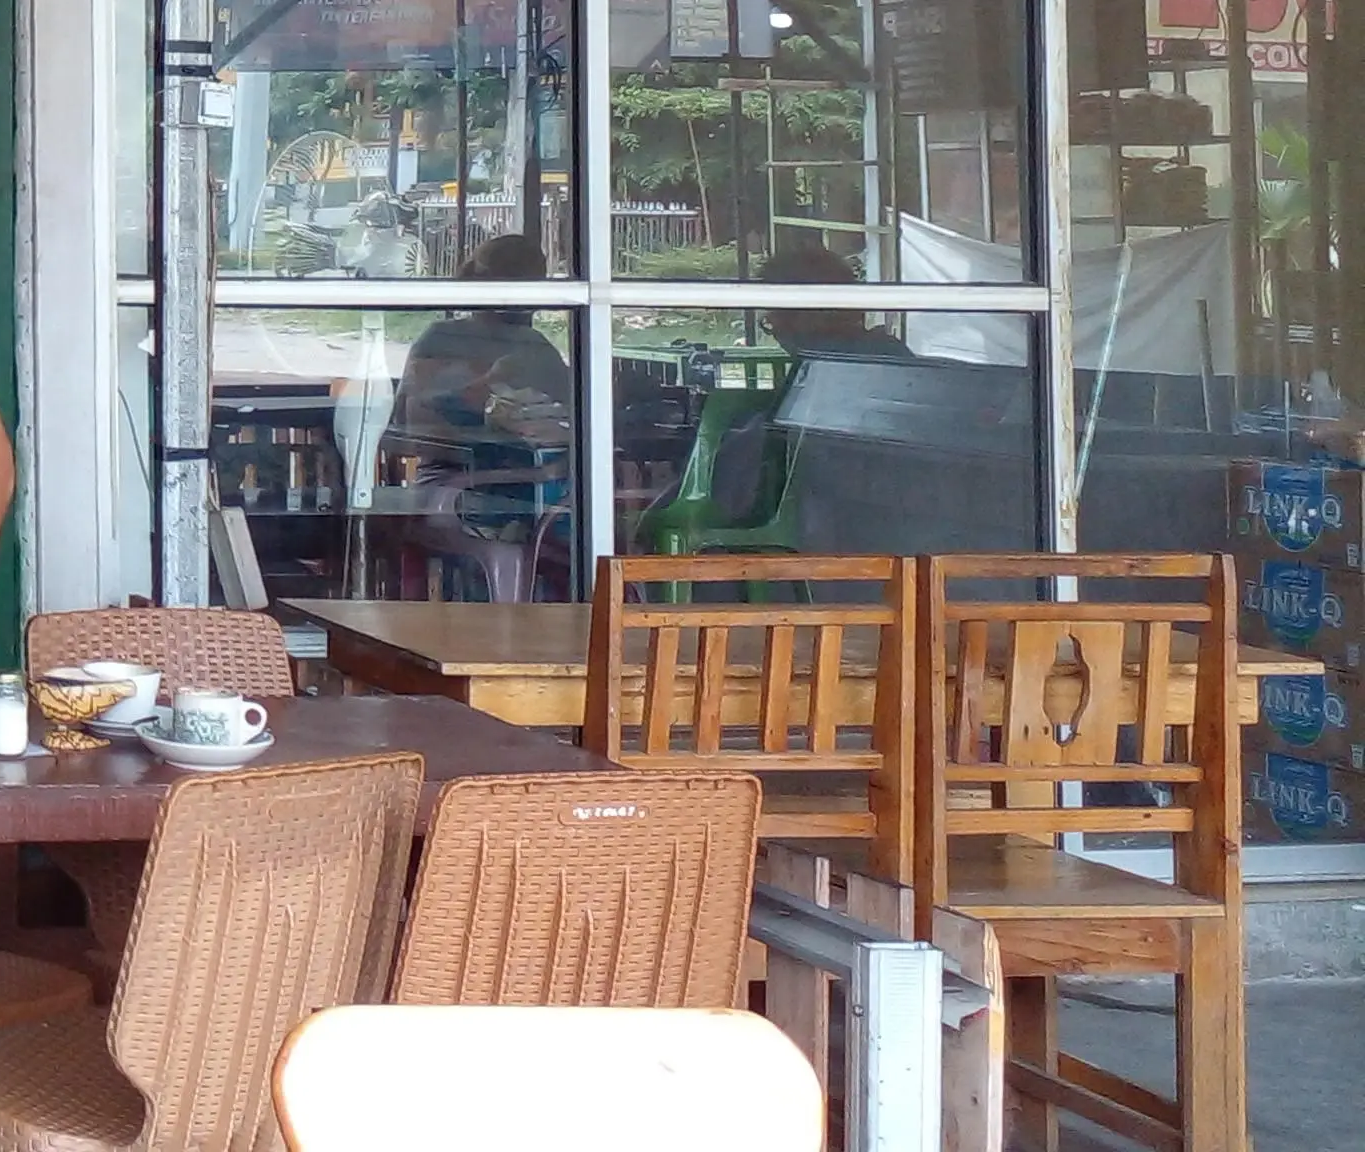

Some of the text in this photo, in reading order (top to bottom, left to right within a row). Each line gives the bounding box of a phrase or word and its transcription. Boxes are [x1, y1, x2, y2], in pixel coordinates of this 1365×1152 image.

[1244, 486, 1343, 529] LINK-Q
[1243, 579, 1344, 629] LINK-Q
[1263, 684, 1347, 729] INK-Q
[1250, 771, 1351, 827] LINK-Q
